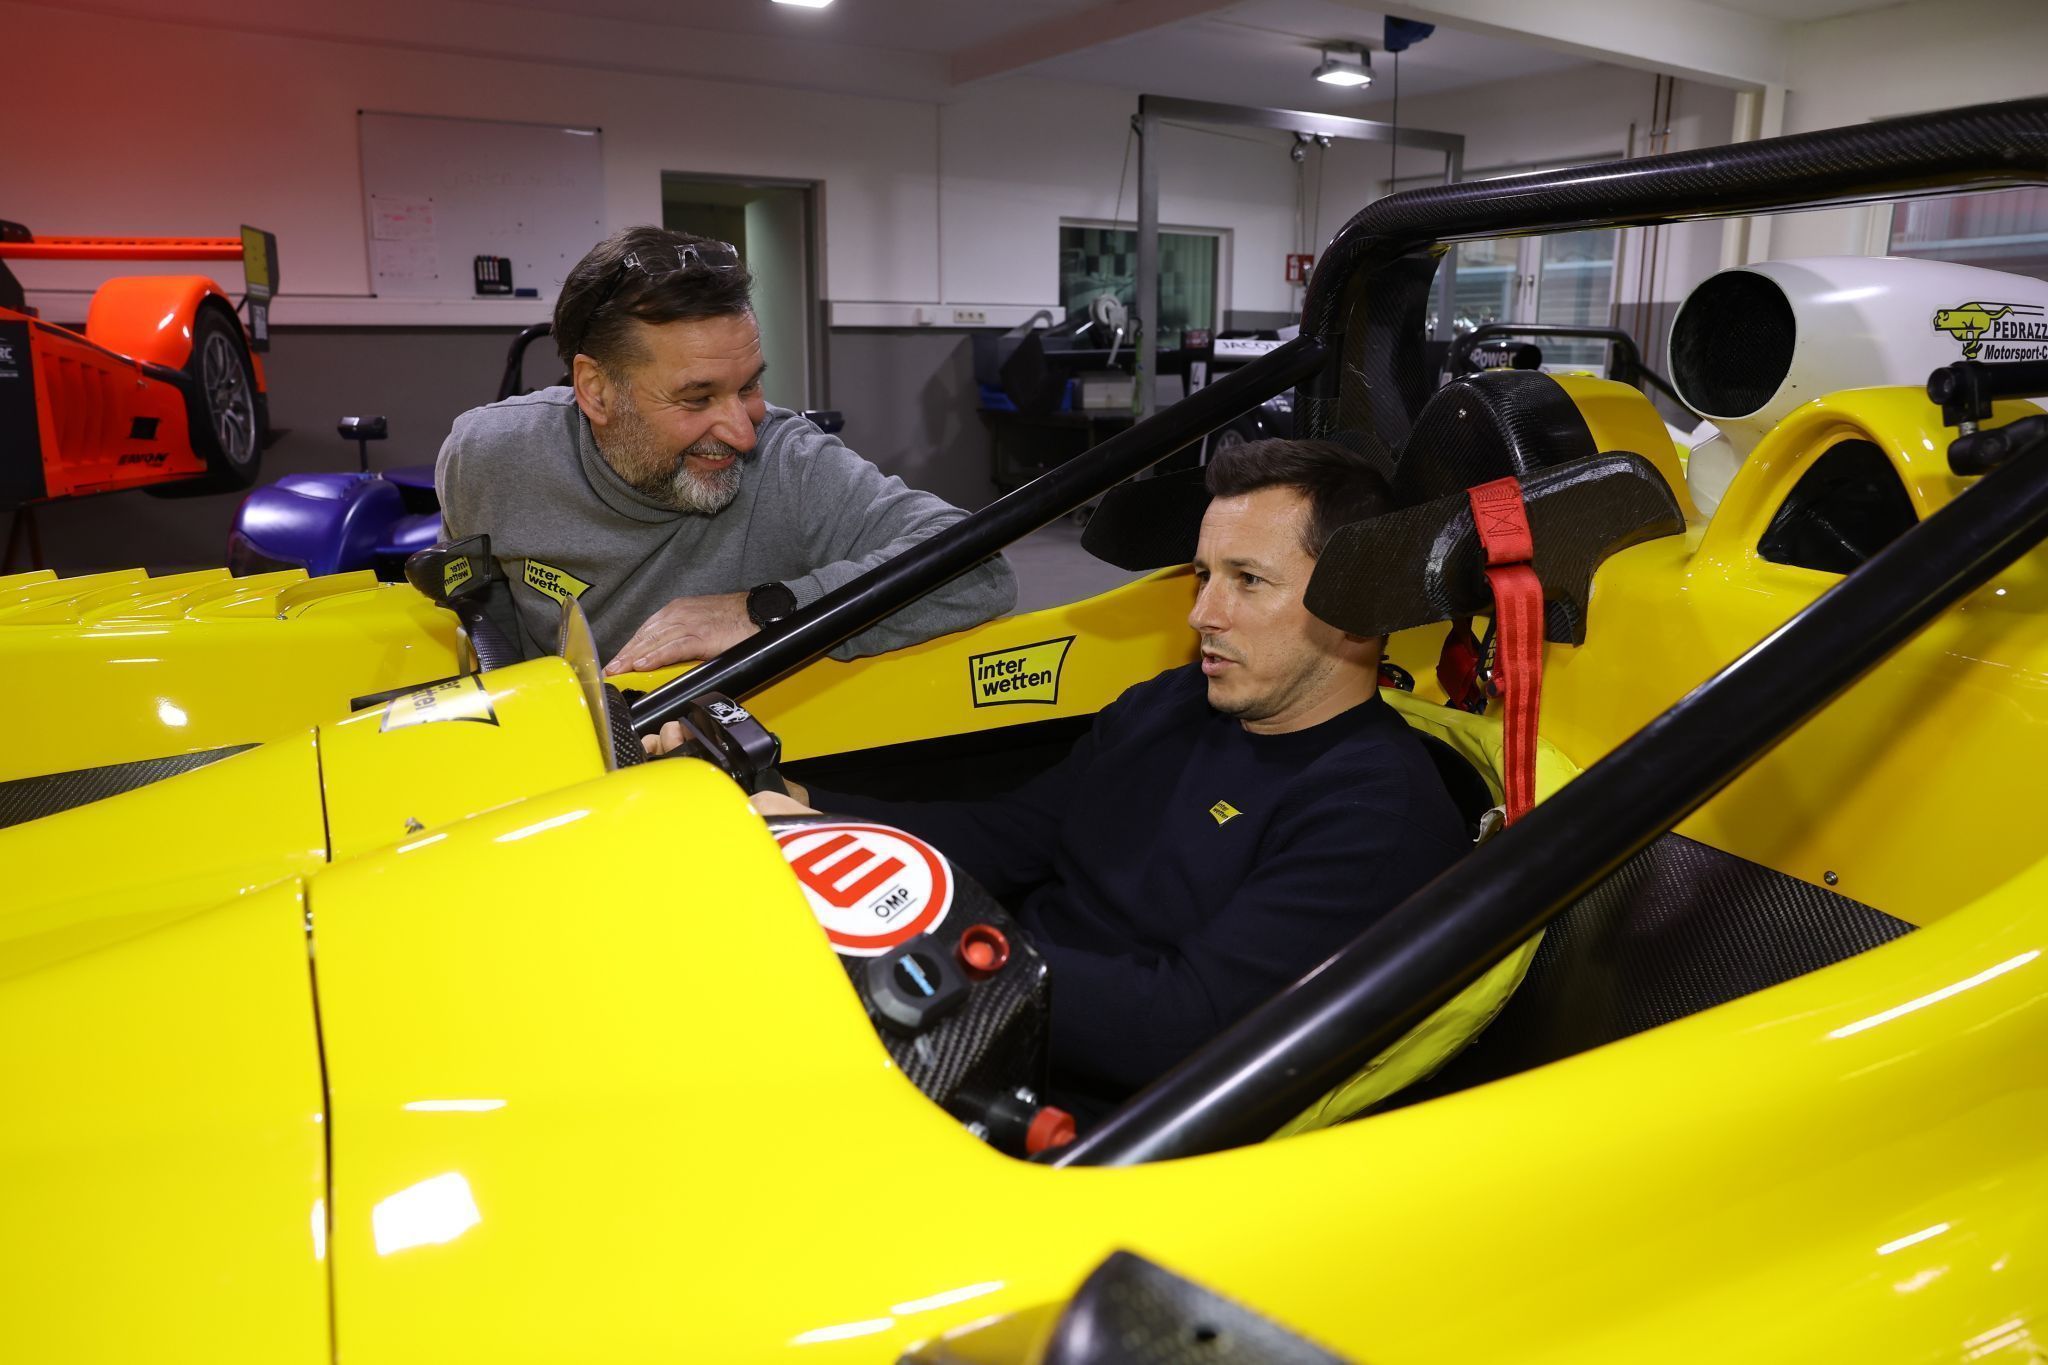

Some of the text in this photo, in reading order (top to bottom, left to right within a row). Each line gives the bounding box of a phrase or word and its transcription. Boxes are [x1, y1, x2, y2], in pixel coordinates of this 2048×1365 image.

[1993, 321, 2048, 339] PEDRAZZ
[1470, 348, 1517, 367] Power
[1984, 344, 2048, 362] Motorsport-C
[526, 559, 562, 582] inter
[977, 657, 1027, 680] inter
[982, 670, 1052, 696] wetten
[875, 888, 909, 918] OMP
